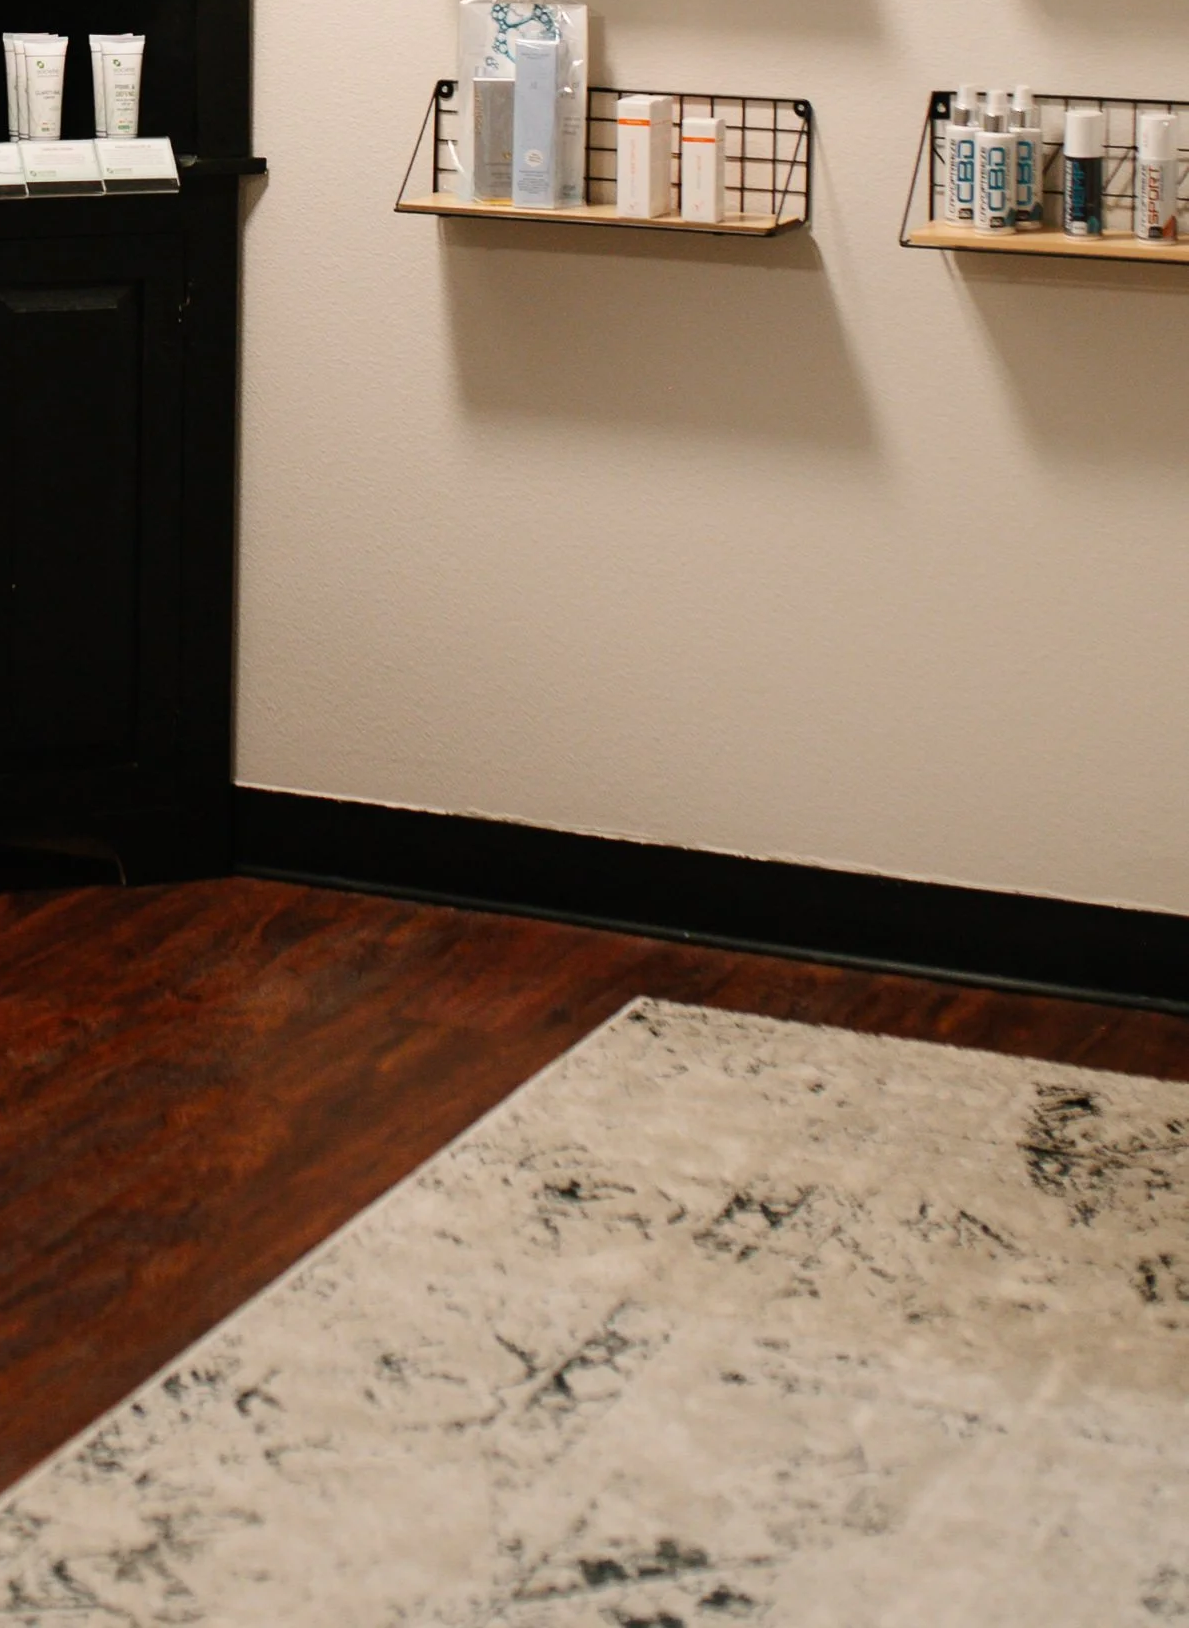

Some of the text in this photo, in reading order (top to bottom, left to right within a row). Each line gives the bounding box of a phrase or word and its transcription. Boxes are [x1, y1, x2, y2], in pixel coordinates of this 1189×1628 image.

[957, 140, 975, 203] CBD
[988, 147, 1006, 211] CBD
[1148, 166, 1160, 225] SPORT
